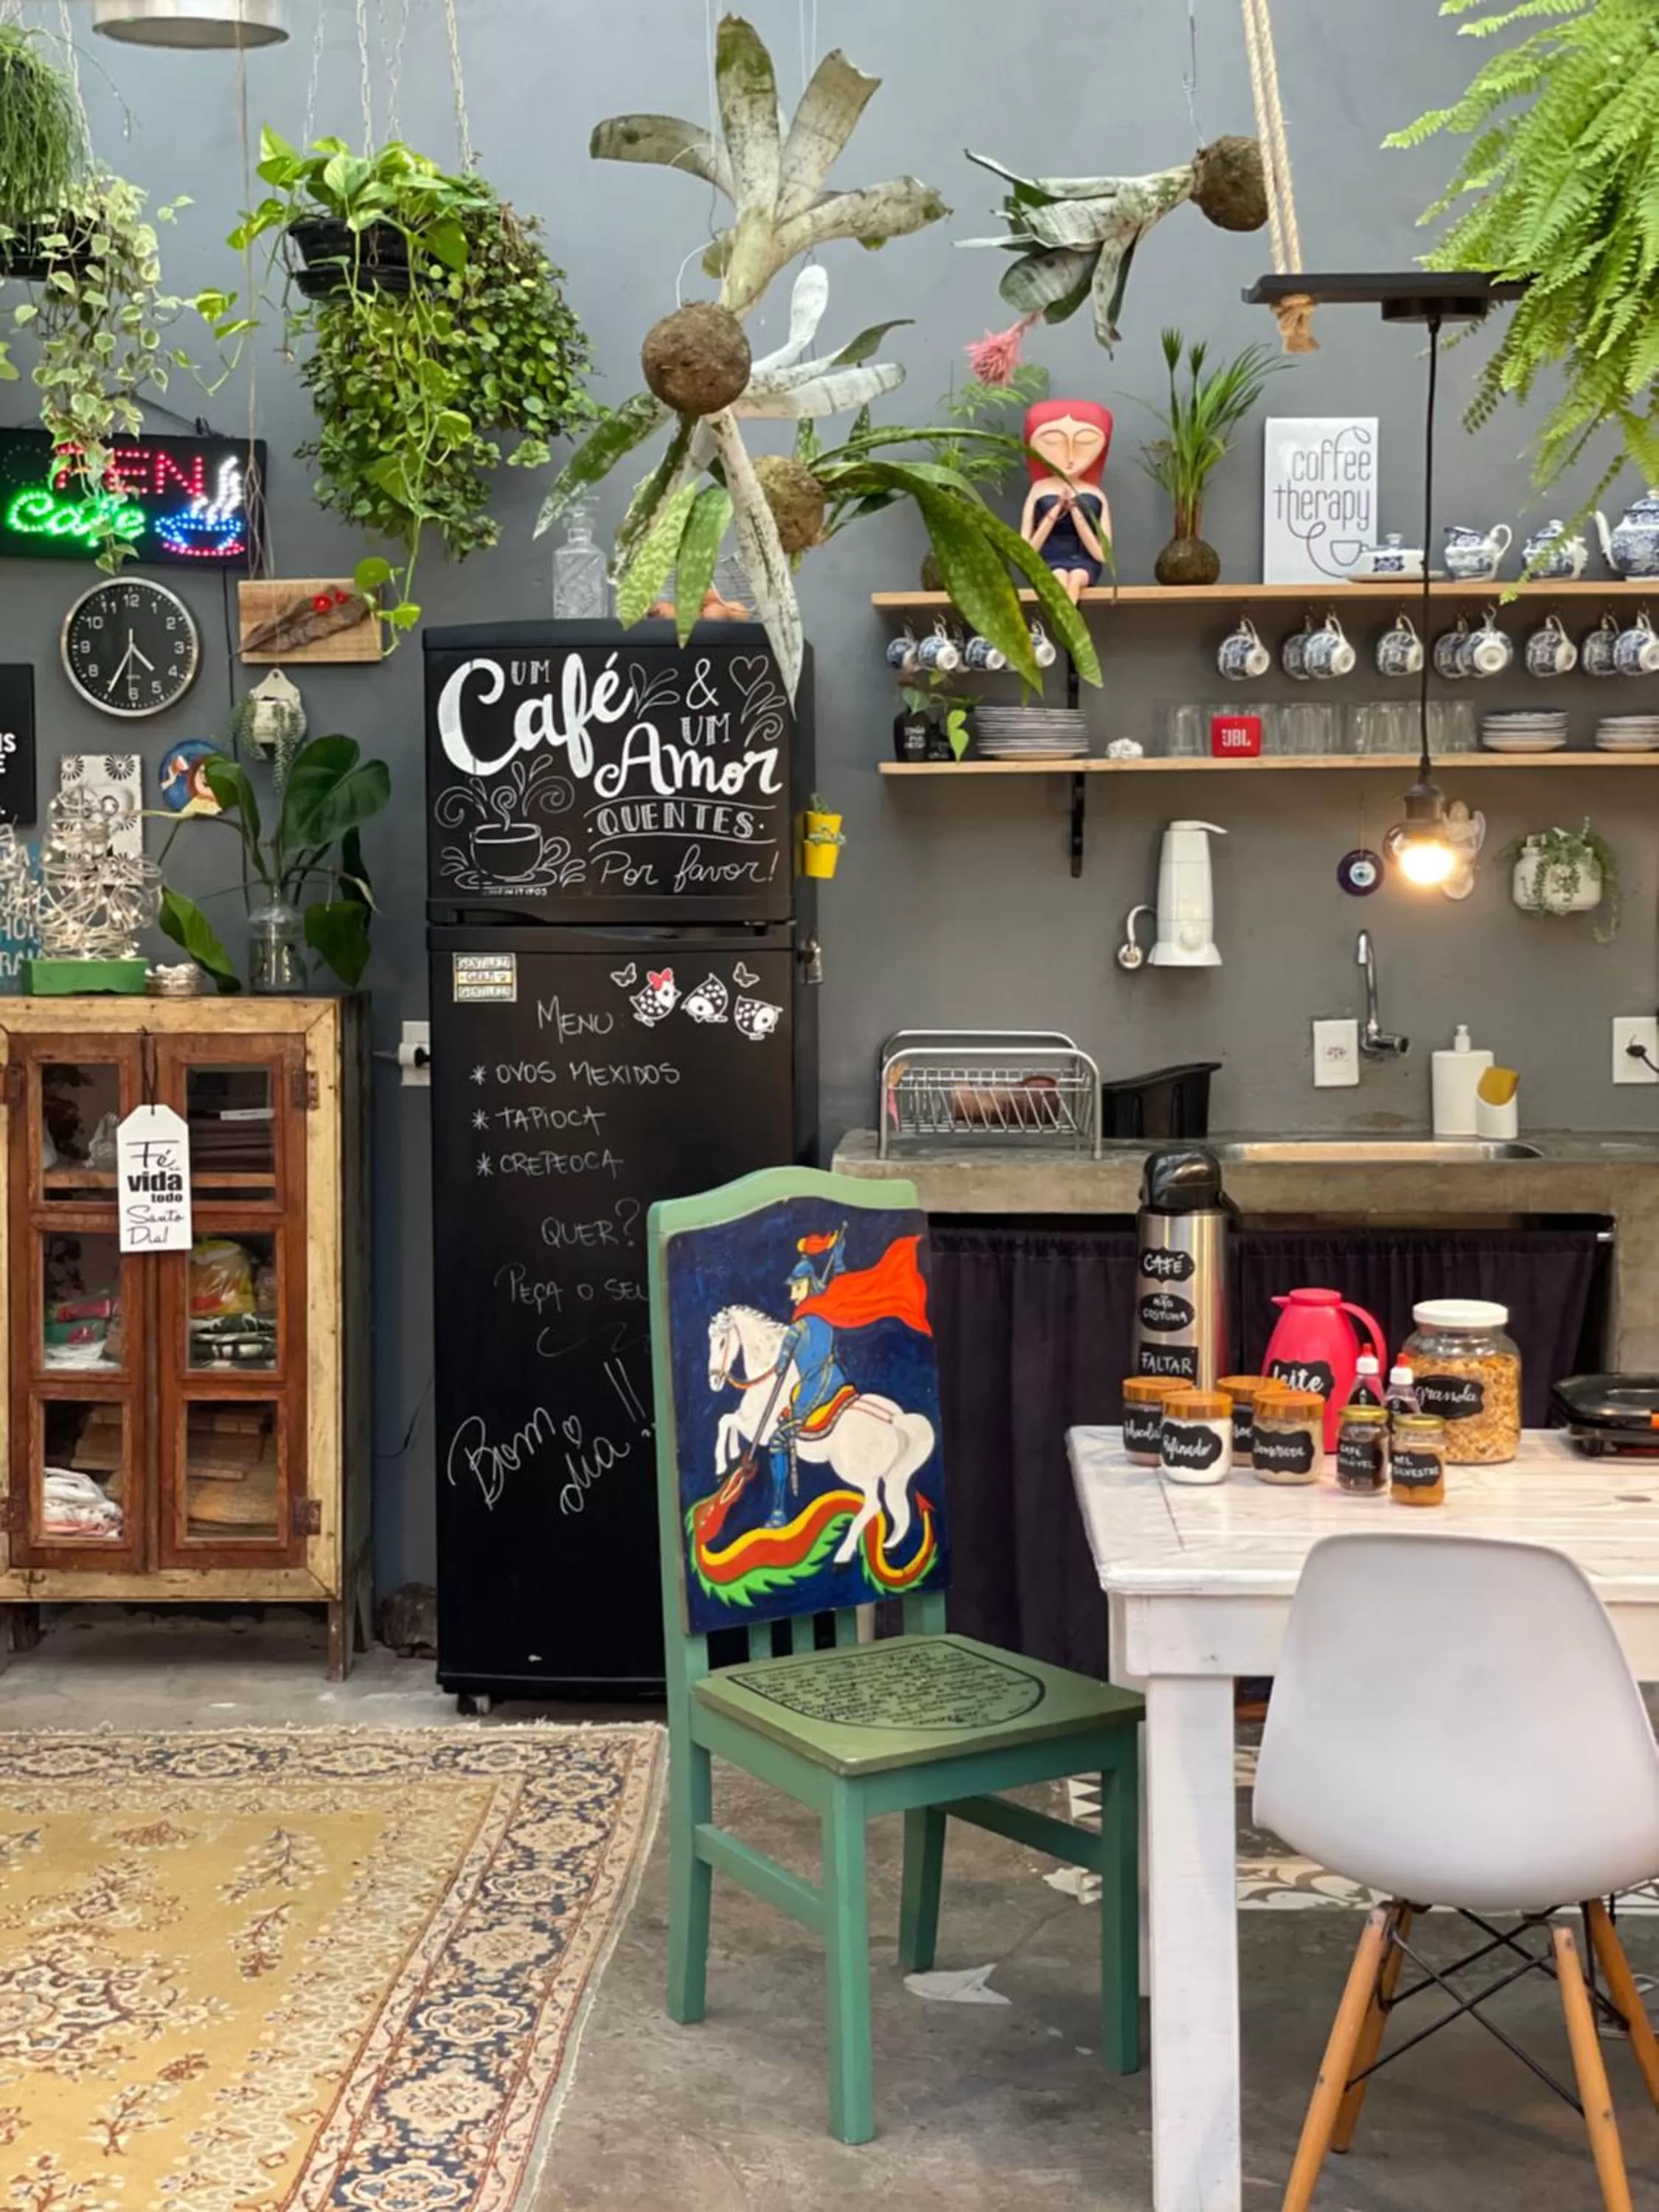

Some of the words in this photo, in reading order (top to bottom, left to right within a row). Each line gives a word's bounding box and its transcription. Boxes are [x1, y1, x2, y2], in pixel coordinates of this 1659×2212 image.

[1292, 428, 1371, 481] coffee
[1273, 480, 1370, 532] therapy
[101, 601, 116, 613] 11
[123, 594, 139, 607] 12
[151, 601, 157, 613] 1
[86, 616, 103, 629] 10
[166, 616, 176, 630] 2
[80, 640, 91, 653] 9
[174, 641, 184, 654] 3
[88, 664, 99, 677] 8
[168, 665, 178, 677] 4
[511, 660, 551, 686] UM
[129, 687, 139, 700] 6
[151, 681, 161, 693] 5
[686, 658, 719, 709] &
[438, 652, 633, 779] Café
[680, 712, 730, 746] UM
[1221, 728, 1251, 746] JBL
[594, 722, 783, 799] Amor
[597, 801, 755, 839] QUENTES
[591, 850, 658, 885] Por
[673, 844, 779, 893] favor!
[495, 1061, 557, 1084] OVOS
[569, 1062, 681, 1086] MEXIDOS
[125, 1140, 179, 1169] Fé
[127, 1171, 183, 1192] vida
[150, 1192, 183, 1203] todo
[126, 1204, 185, 1225] Santo
[540, 1197, 641, 1249] QUER?
[1144, 1253, 1186, 1275] CAFÉ
[1141, 1351, 1193, 1374] FALTAR
[1415, 1383, 1478, 1407] granola
[448, 1407, 556, 1511] Bom
